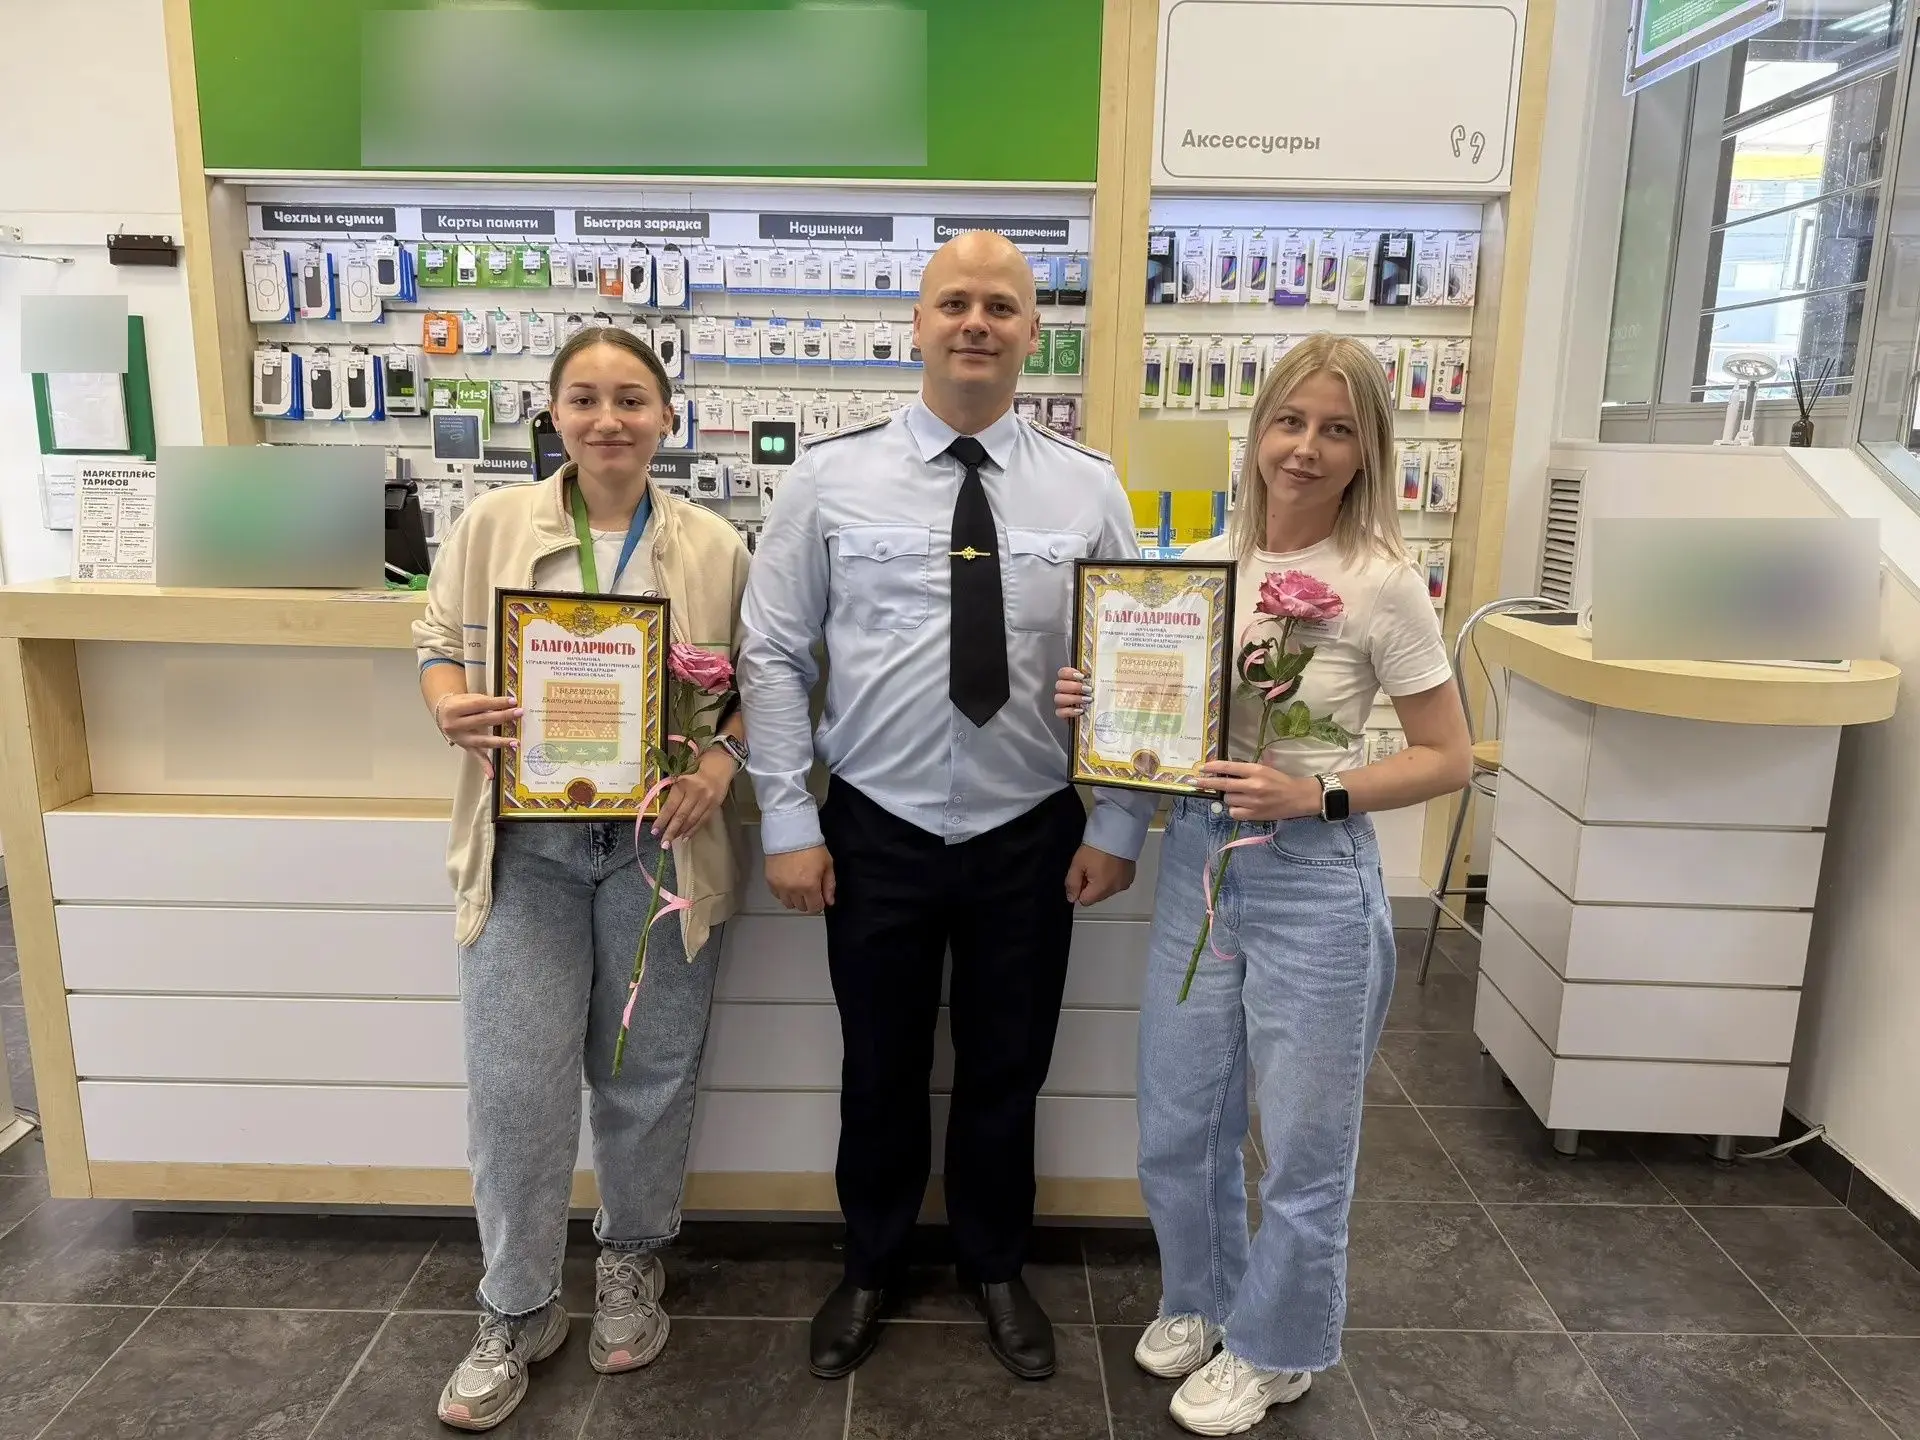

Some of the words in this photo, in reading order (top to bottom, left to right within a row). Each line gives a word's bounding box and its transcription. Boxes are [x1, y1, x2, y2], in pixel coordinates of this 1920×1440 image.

[1181, 128, 1321, 153] Аксессуары
[273, 210, 321, 224] Чехлы
[324, 215, 333, 224] и
[335, 215, 384, 226] сумки
[437, 215, 483, 229] Карты
[486, 218, 539, 229] памяти
[583, 216, 641, 230] Быстрая
[643, 219, 702, 231] зарядка
[789, 221, 864, 236] Наушники
[996, 227, 1067, 238] развлечения
[459, 389, 488, 400] 1+1=3
[82, 470, 156, 479] МАРКЕТПЛЕЙС
[82, 478, 129, 487] ТАРИФОВ
[1104, 609, 1201, 626] БЛАГОДАРНОСТЬ
[531, 639, 636, 656] БЛАГОДАРНОСТЬ
